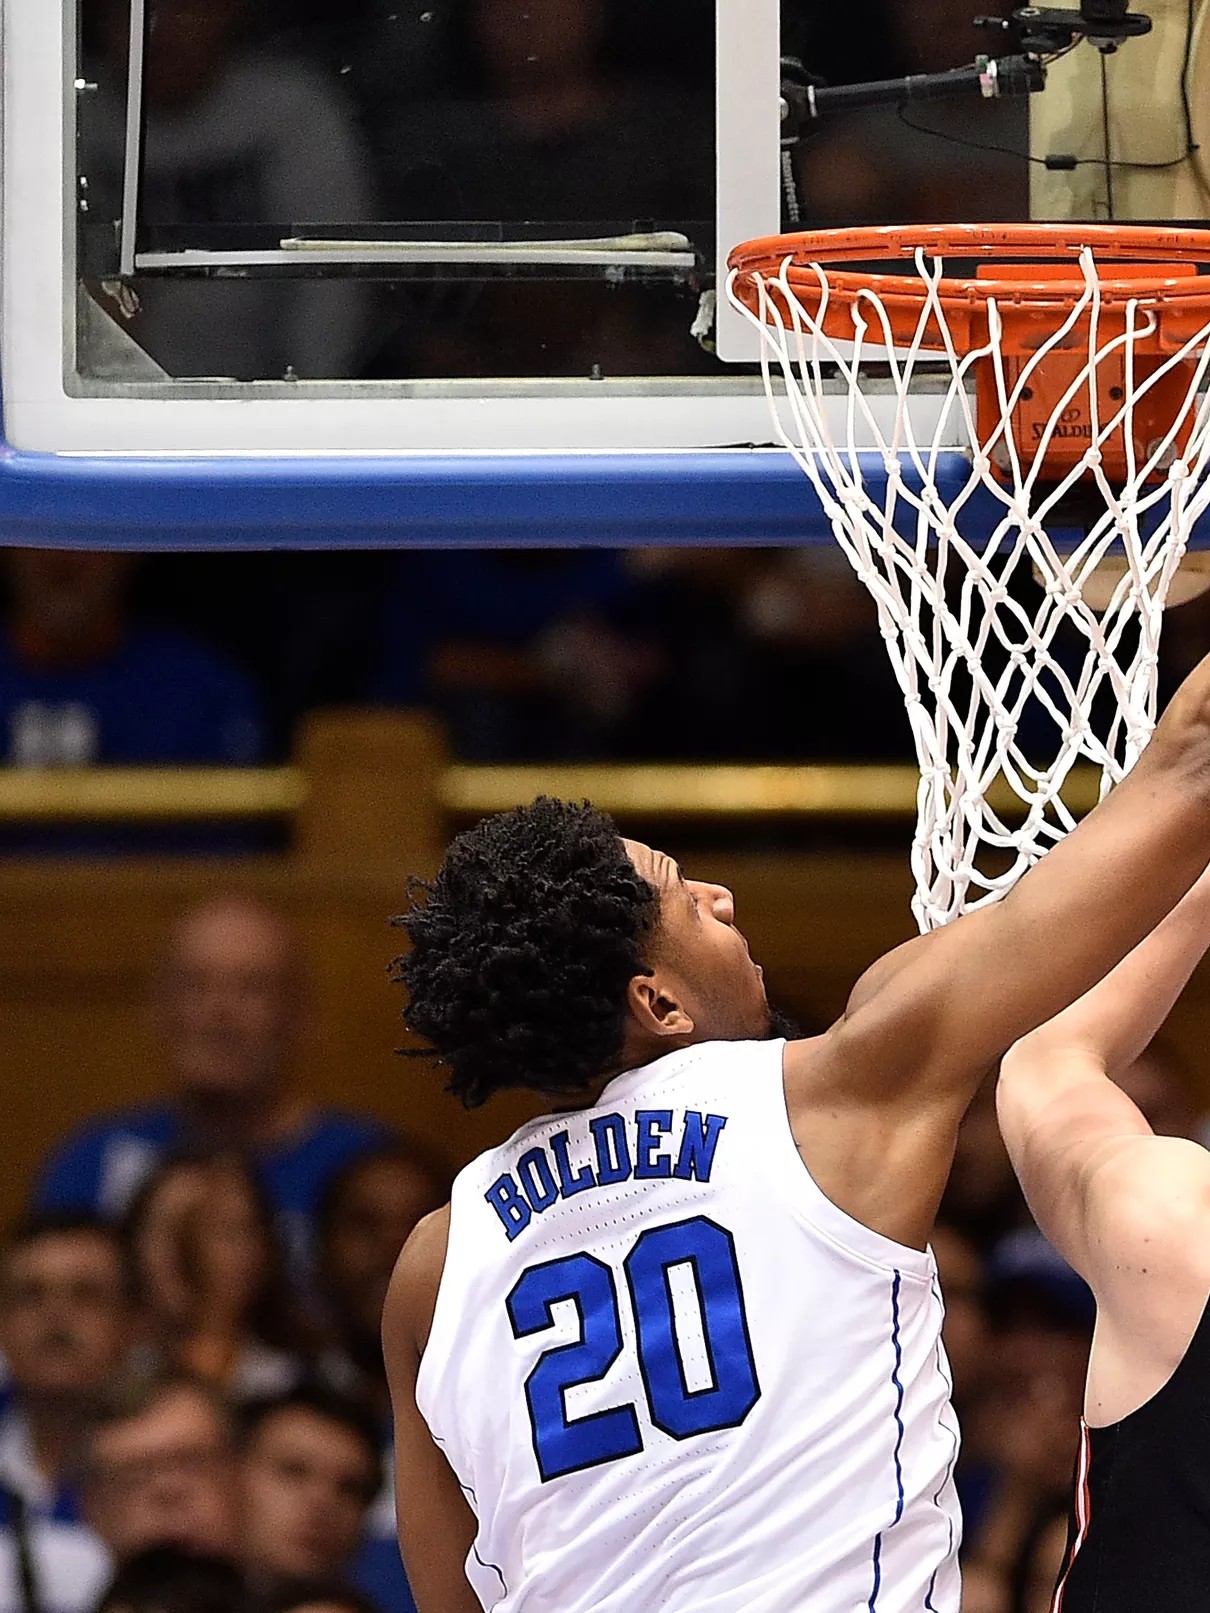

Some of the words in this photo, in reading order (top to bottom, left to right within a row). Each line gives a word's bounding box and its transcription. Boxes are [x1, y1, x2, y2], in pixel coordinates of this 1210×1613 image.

[1032, 422, 1112, 440] SALDI
[484, 1109, 728, 1242] BOLDEN
[505, 1215, 762, 1483] 20
